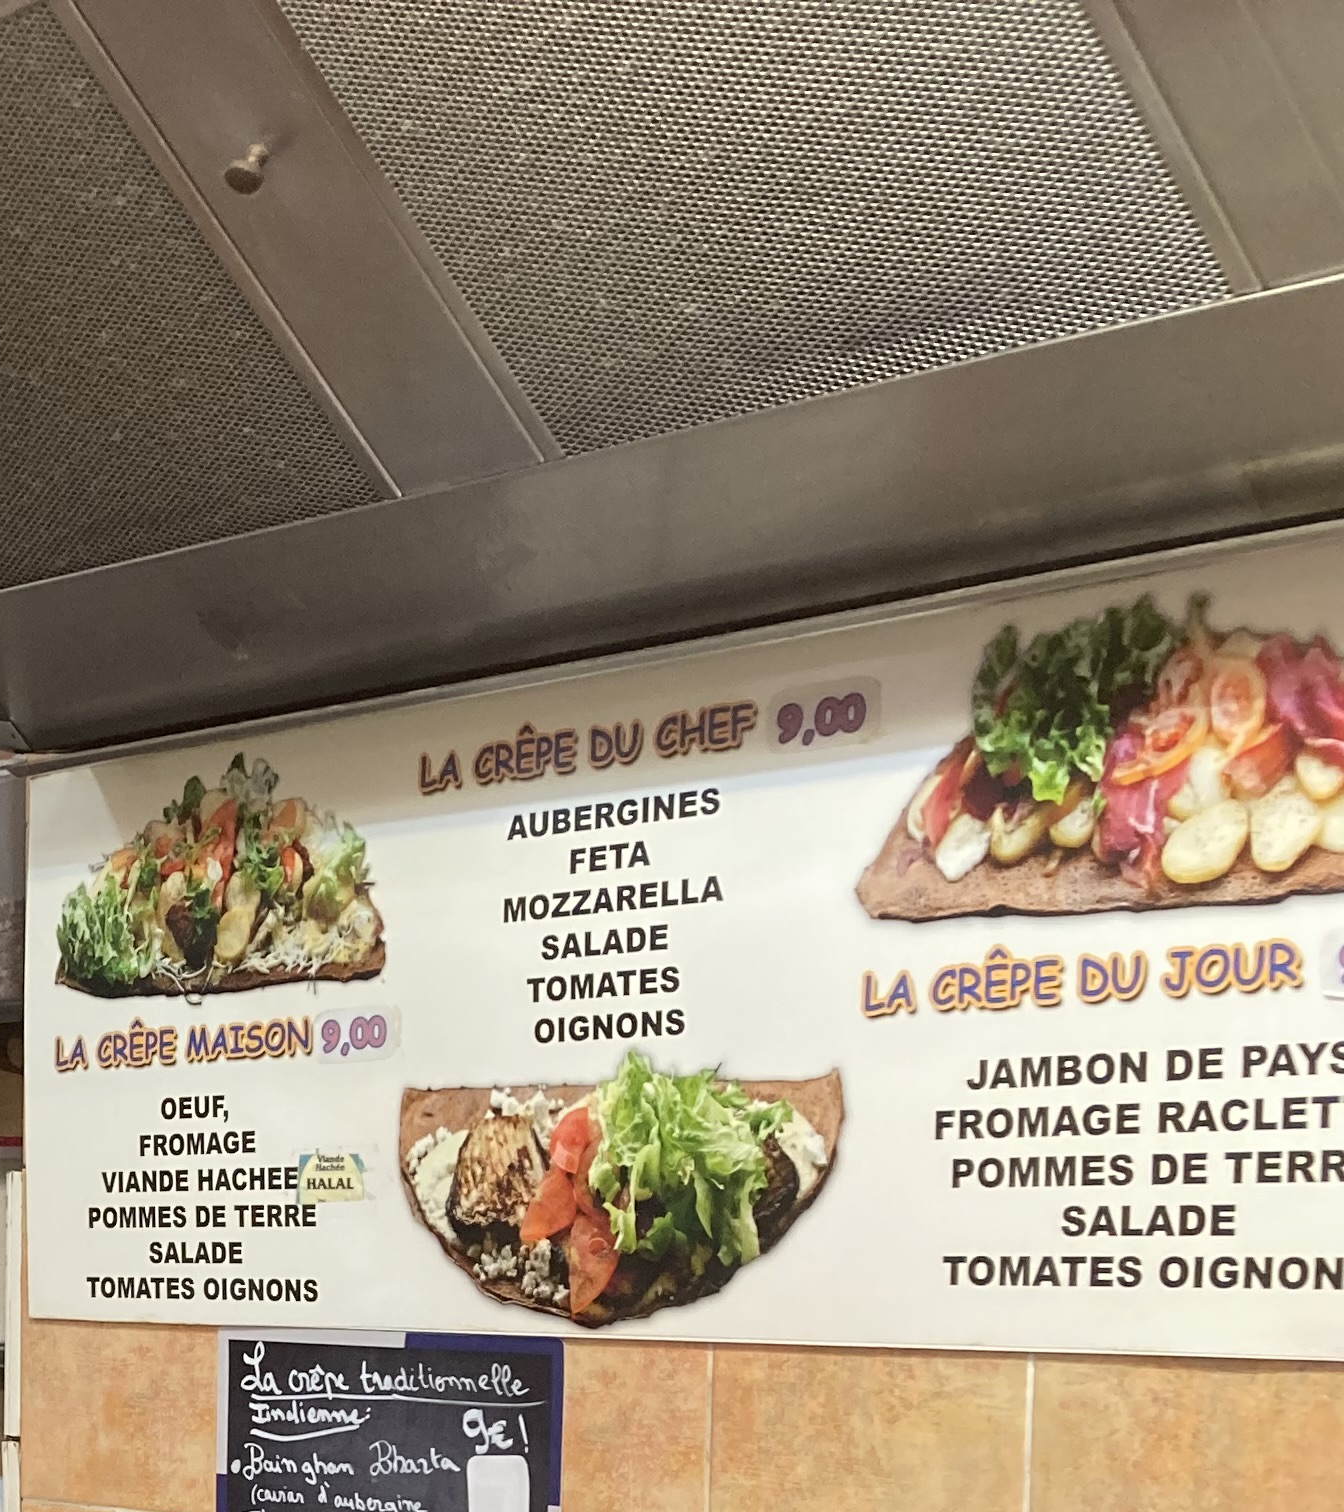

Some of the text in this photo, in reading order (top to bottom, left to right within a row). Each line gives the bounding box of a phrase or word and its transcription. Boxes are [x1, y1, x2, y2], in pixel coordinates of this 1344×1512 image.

[419, 692, 867, 793] LA CRÊPE DU CHEF 9,00
[507, 787, 721, 840] AUBERGINES
[568, 841, 651, 875] FETA
[502, 875, 725, 924] MOZZARELLA
[541, 924, 669, 961] SALADE
[527, 966, 681, 1004] TOMATES
[861, 940, 1301, 1017] LA CRÊPE DU JOUR
[54, 1014, 387, 1072] LA CRÊPE MAISON 9,00
[534, 1009, 686, 1045] OIGNONS
[966, 1051, 1148, 1090] JAMBON
[1166, 1048, 1224, 1082] DE
[161, 1094, 230, 1122] OEUF,
[934, 1096, 1344, 1141] FROMAGE RACLET
[139, 1130, 257, 1157] FROMAGE
[101, 1166, 298, 1195] VIANDE HACHEE
[306, 1177, 354, 1190] HALAL
[951, 1149, 1344, 1189] POMMES DE TERR
[87, 1203, 317, 1231] POMMES DE TERRE
[1061, 1204, 1238, 1238] SALADE
[148, 1241, 244, 1266] SALADE
[86, 1276, 319, 1303] TOMATES OIGNONS
[943, 1254, 1344, 1291] TOMATES OIGNON
[240, 1340, 530, 1400] La crêpe traditionnelle
